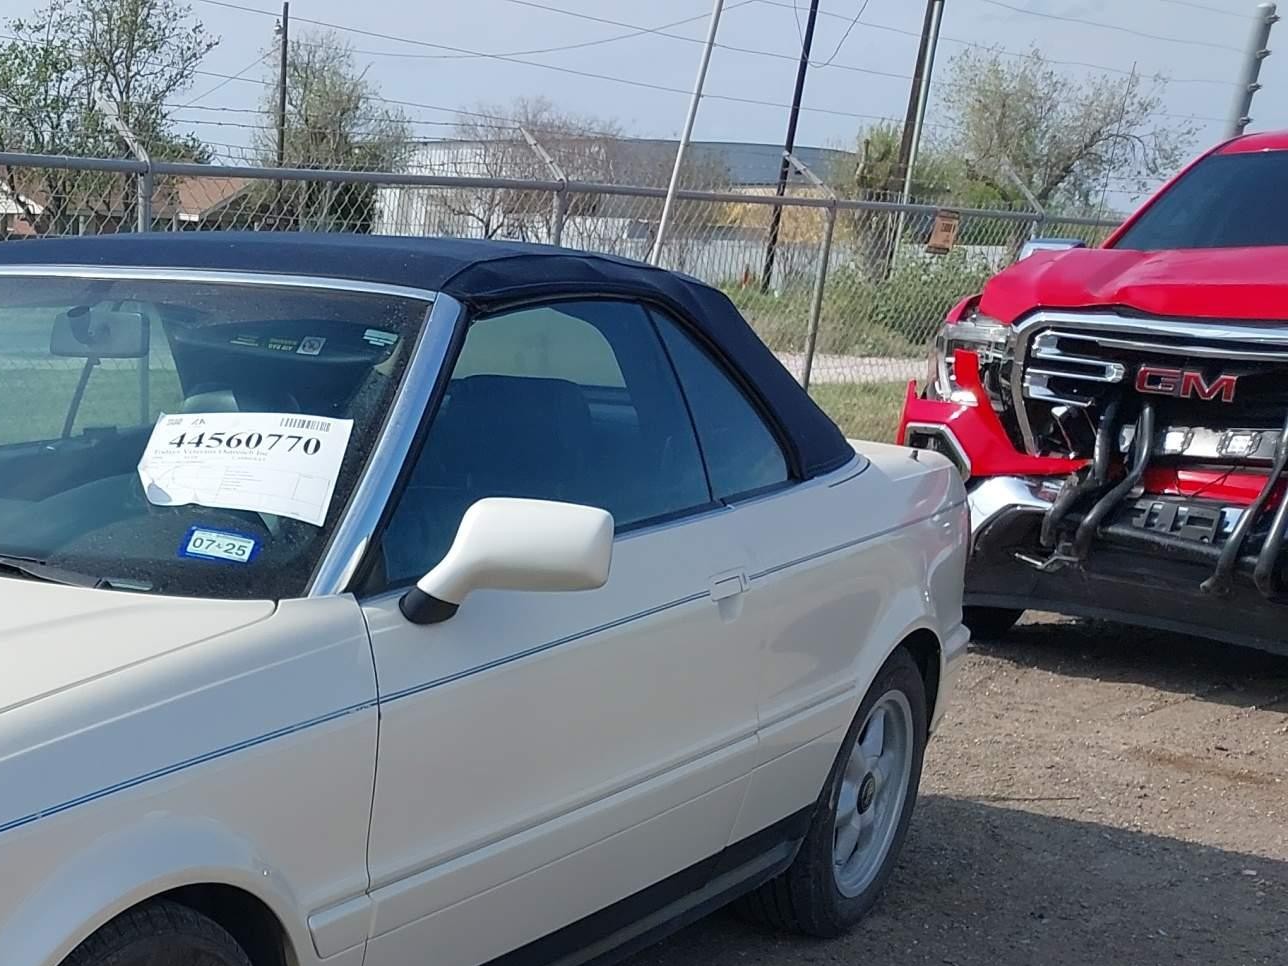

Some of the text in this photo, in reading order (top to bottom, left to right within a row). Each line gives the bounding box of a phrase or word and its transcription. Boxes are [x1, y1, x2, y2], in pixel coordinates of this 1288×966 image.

[1135, 366, 1239, 403] GM
[169, 431, 321, 456] 44560770
[192, 537, 248, 557] 07 25
